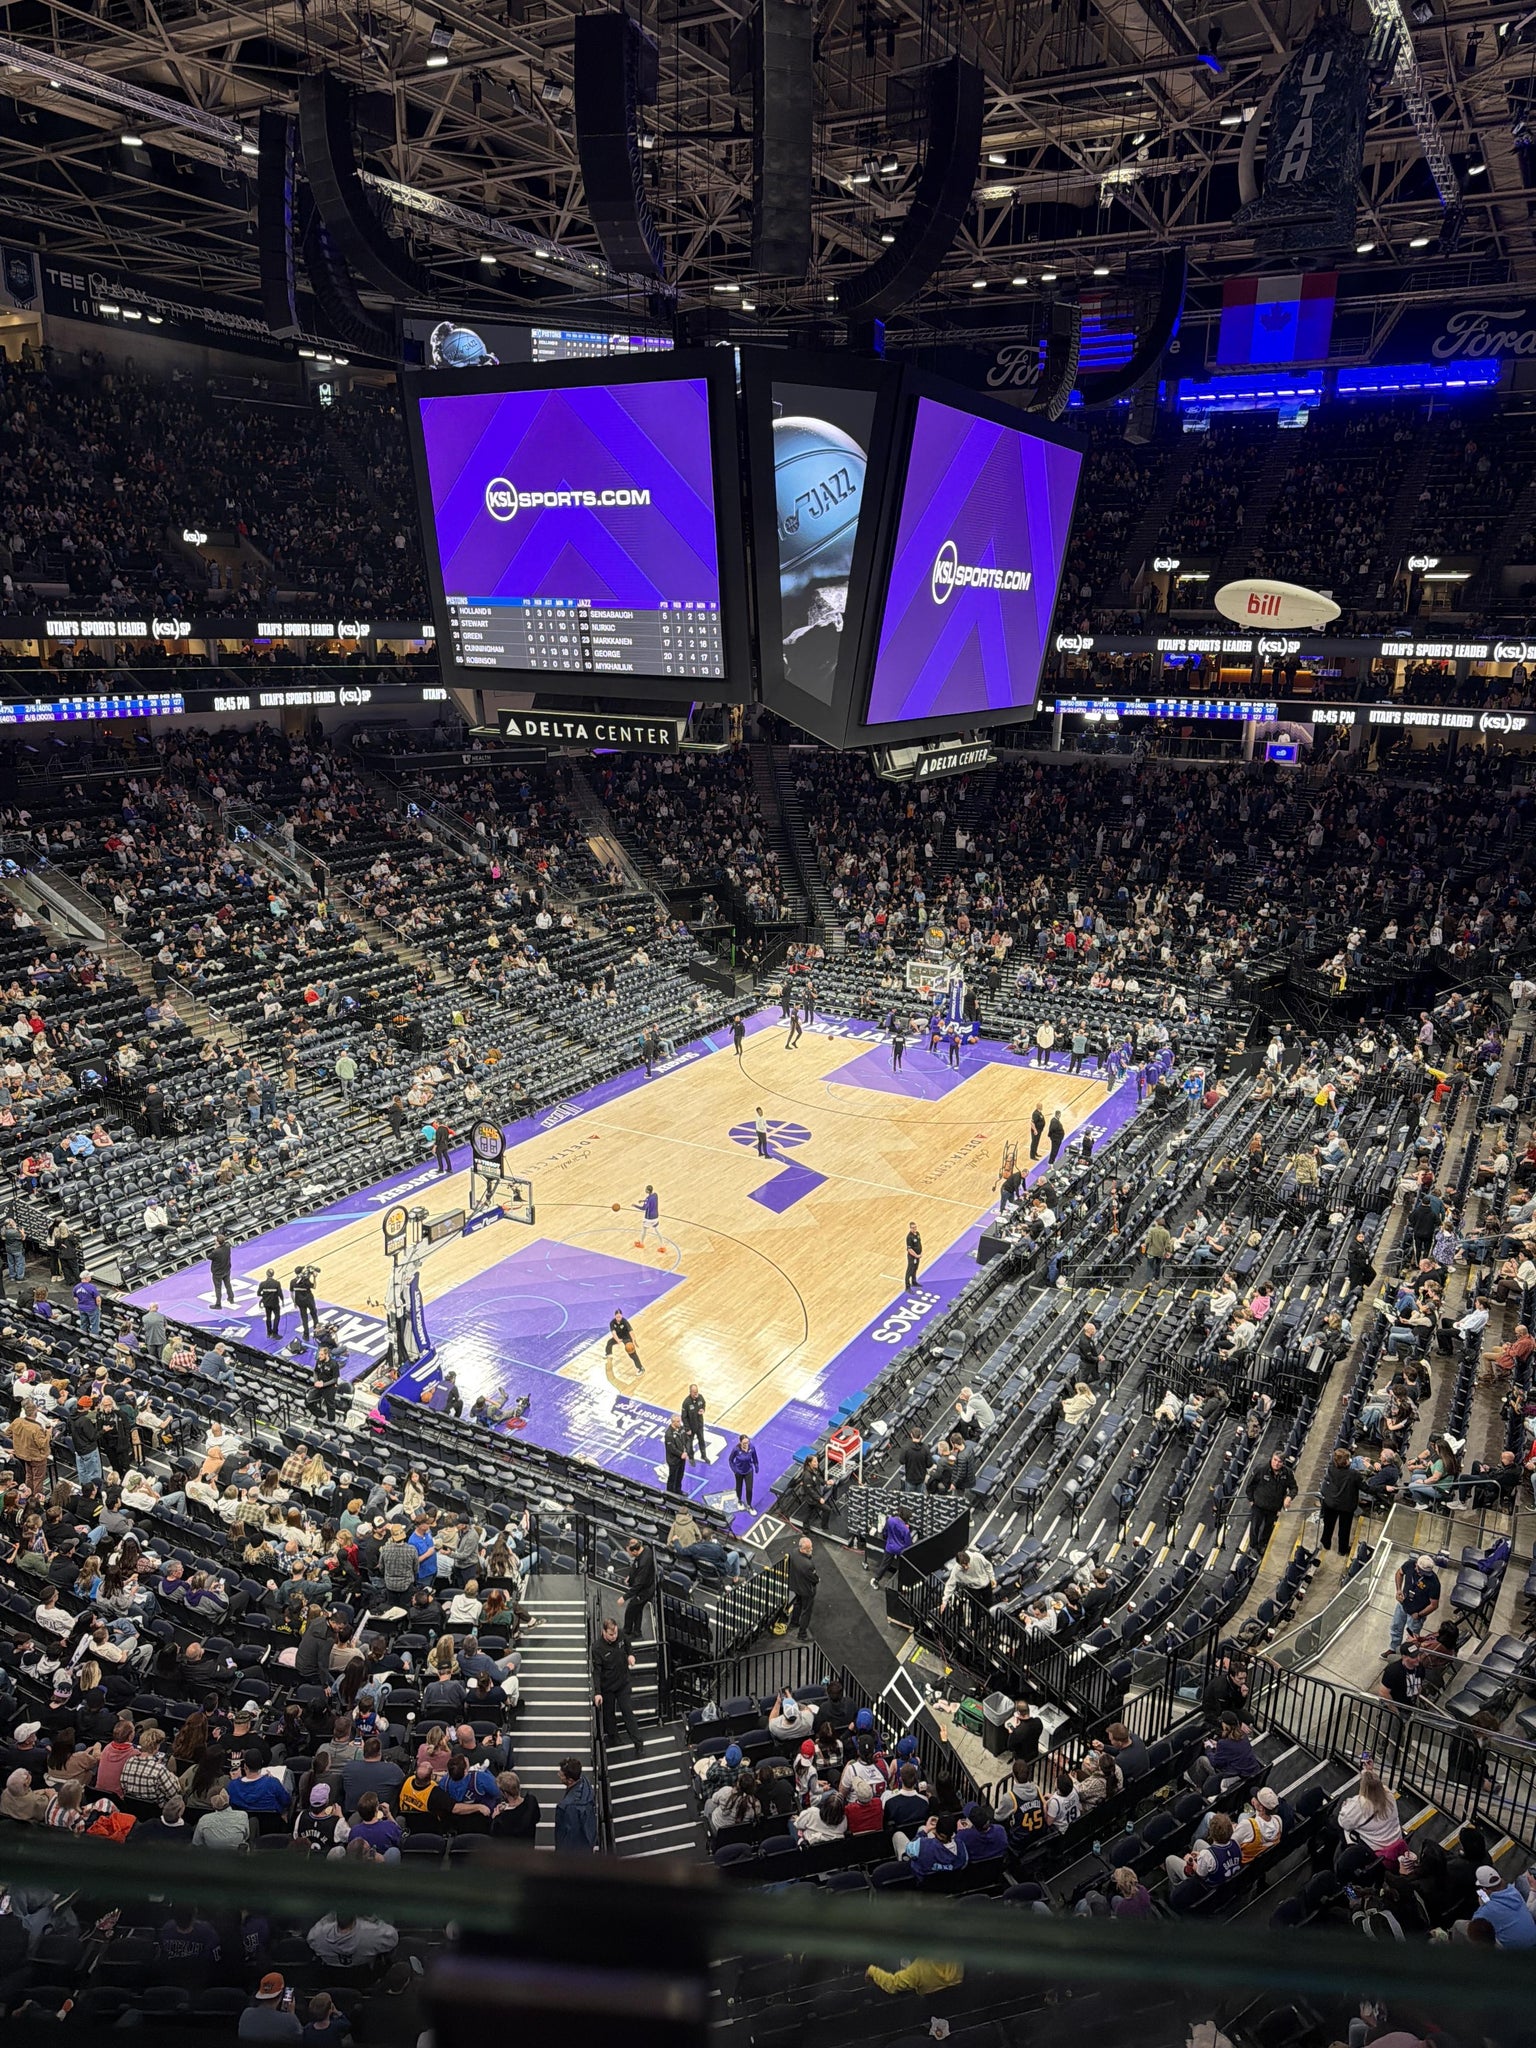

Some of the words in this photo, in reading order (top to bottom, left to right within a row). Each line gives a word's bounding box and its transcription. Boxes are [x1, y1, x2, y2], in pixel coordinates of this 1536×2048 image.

[1279, 52, 1332, 183] UTAH
[46, 268, 85, 291] TEE
[808, 467, 856, 519] JAZZ
[1247, 592, 1282, 617] bill
[81, 620, 116, 637] SPORTS
[117, 621, 147, 637] LEADER
[284, 623, 310, 637] SPORTS
[311, 623, 334, 638] LEADER
[593, 637, 633, 646] MARKKANEN
[1188, 639, 1221, 652] SPORTS
[1222, 639, 1253, 653] LEADER
[1417, 643, 1453, 657] SPORTS
[1454, 644, 1488, 658] LEADER
[594, 650, 621, 658] GEORGE
[236, 696, 250, 710] PM
[285, 691, 312, 706] SPORTS
[312, 690, 336, 706] LEADER
[1338, 711, 1355, 724] PM
[1402, 712, 1438, 727] SPORTS
[1440, 713, 1474, 728] LEADER
[525, 720, 589, 739] DELTA
[595, 724, 670, 745] CENTER
[929, 755, 958, 774] DELTA
[959, 747, 988, 769] CENTER
[871, 1298, 933, 1344] PACS
[1021, 1809, 1043, 1831] 45
[1065, 1805, 1078, 1824] 19
